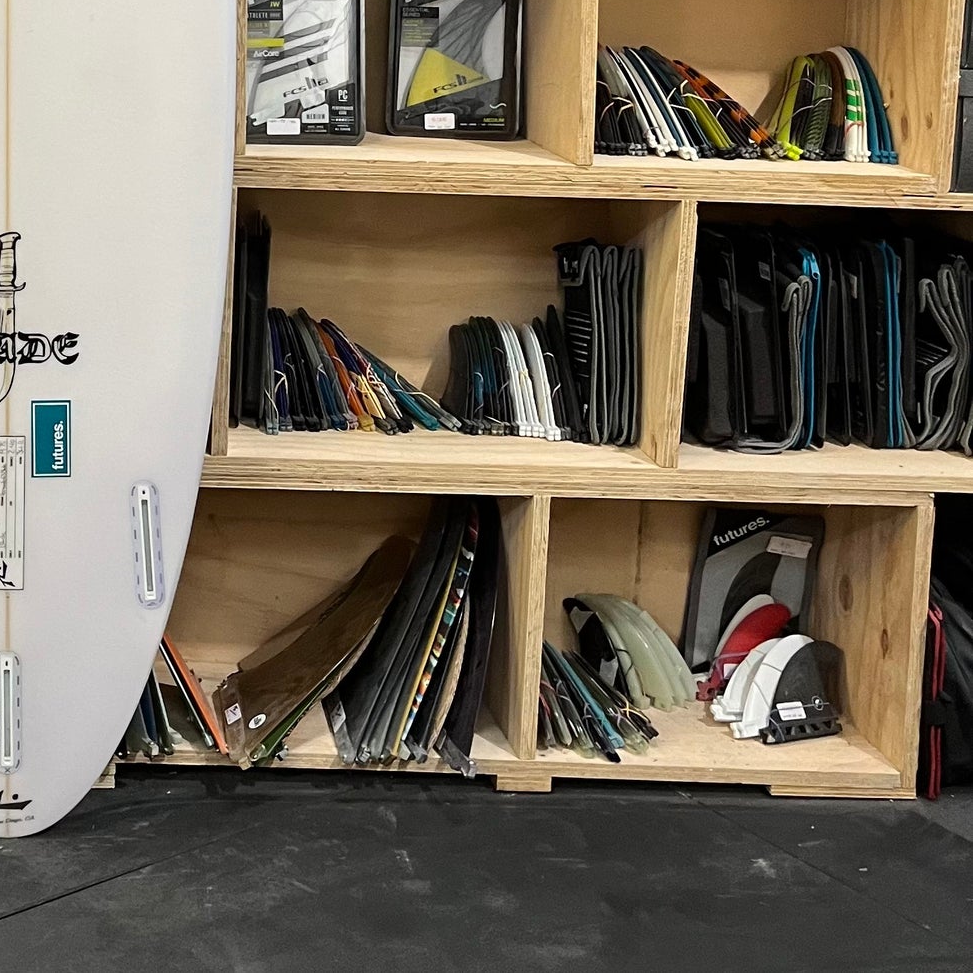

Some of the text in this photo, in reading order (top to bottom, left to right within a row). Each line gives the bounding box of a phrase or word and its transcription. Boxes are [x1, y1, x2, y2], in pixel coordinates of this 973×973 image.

[253, 50, 280, 58] AirCore
[283, 85, 307, 98] FCS
[433, 82, 458, 94] FCS
[338, 89, 348, 100] PC
[52, 420, 64, 470] futures.
[713, 515, 771, 546] futures.
